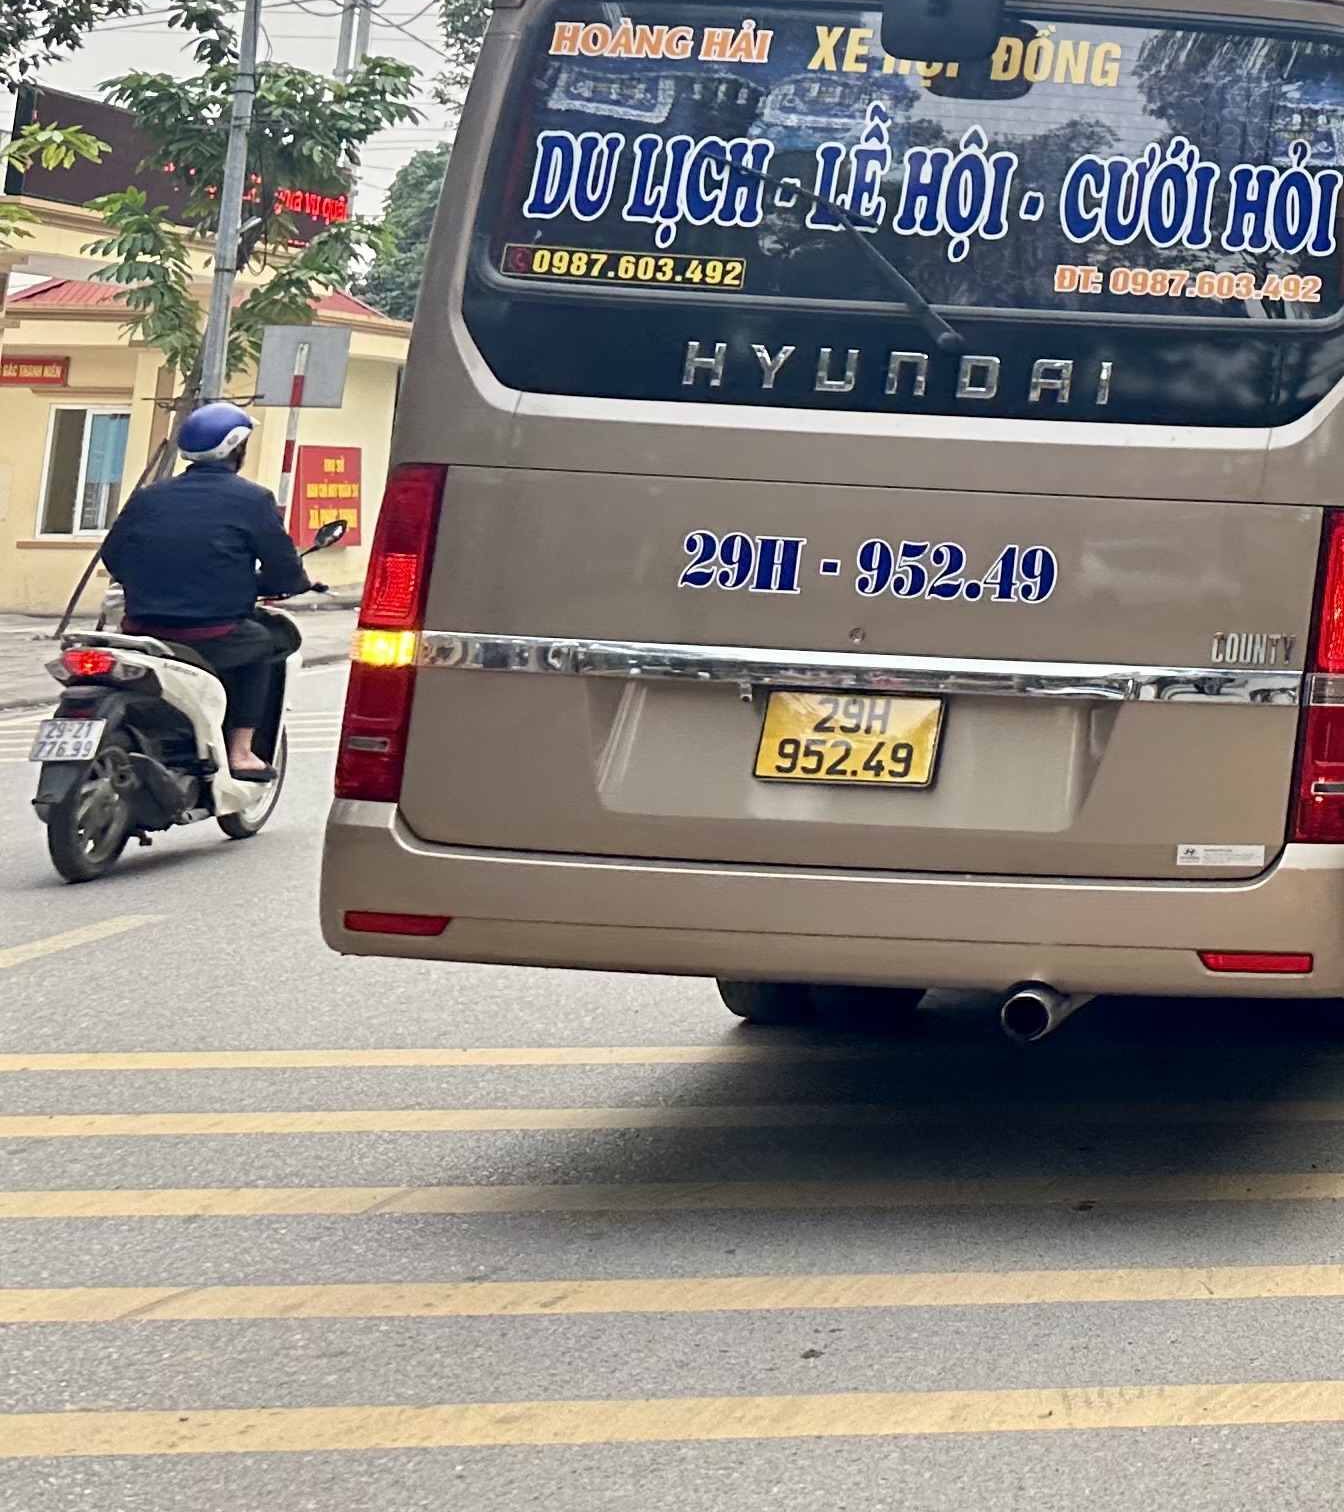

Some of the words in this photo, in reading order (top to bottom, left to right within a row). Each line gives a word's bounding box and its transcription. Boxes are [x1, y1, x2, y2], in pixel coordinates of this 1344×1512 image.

[549, 18, 694, 59] HOÀNG
[698, 19, 774, 63] HẢI
[807, 25, 873, 72] XE
[990, 24, 1122, 87] ĐỒNG
[523, 130, 625, 221] DU
[622, 134, 775, 248] LỊCH
[805, 100, 892, 234] LỄ
[893, 124, 1018, 263] HỘI
[1059, 136, 1220, 249] CƯỚI
[1221, 138, 1344, 256] HỎI
[532, 249, 743, 285] 0987.603.492
[1054, 265, 1103, 294] ĐT:
[1109, 267, 1322, 302] 0987.603.492
[682, 341, 1113, 405] HYUNDAI
[678, 530, 807, 594] 29H
[855, 538, 1058, 604] 952.49
[1211, 631, 1296, 665] COUNTY
[812, 696, 893, 735] 29H
[35, 740, 93, 759] 776.99
[774, 737, 914, 779] 952.49
